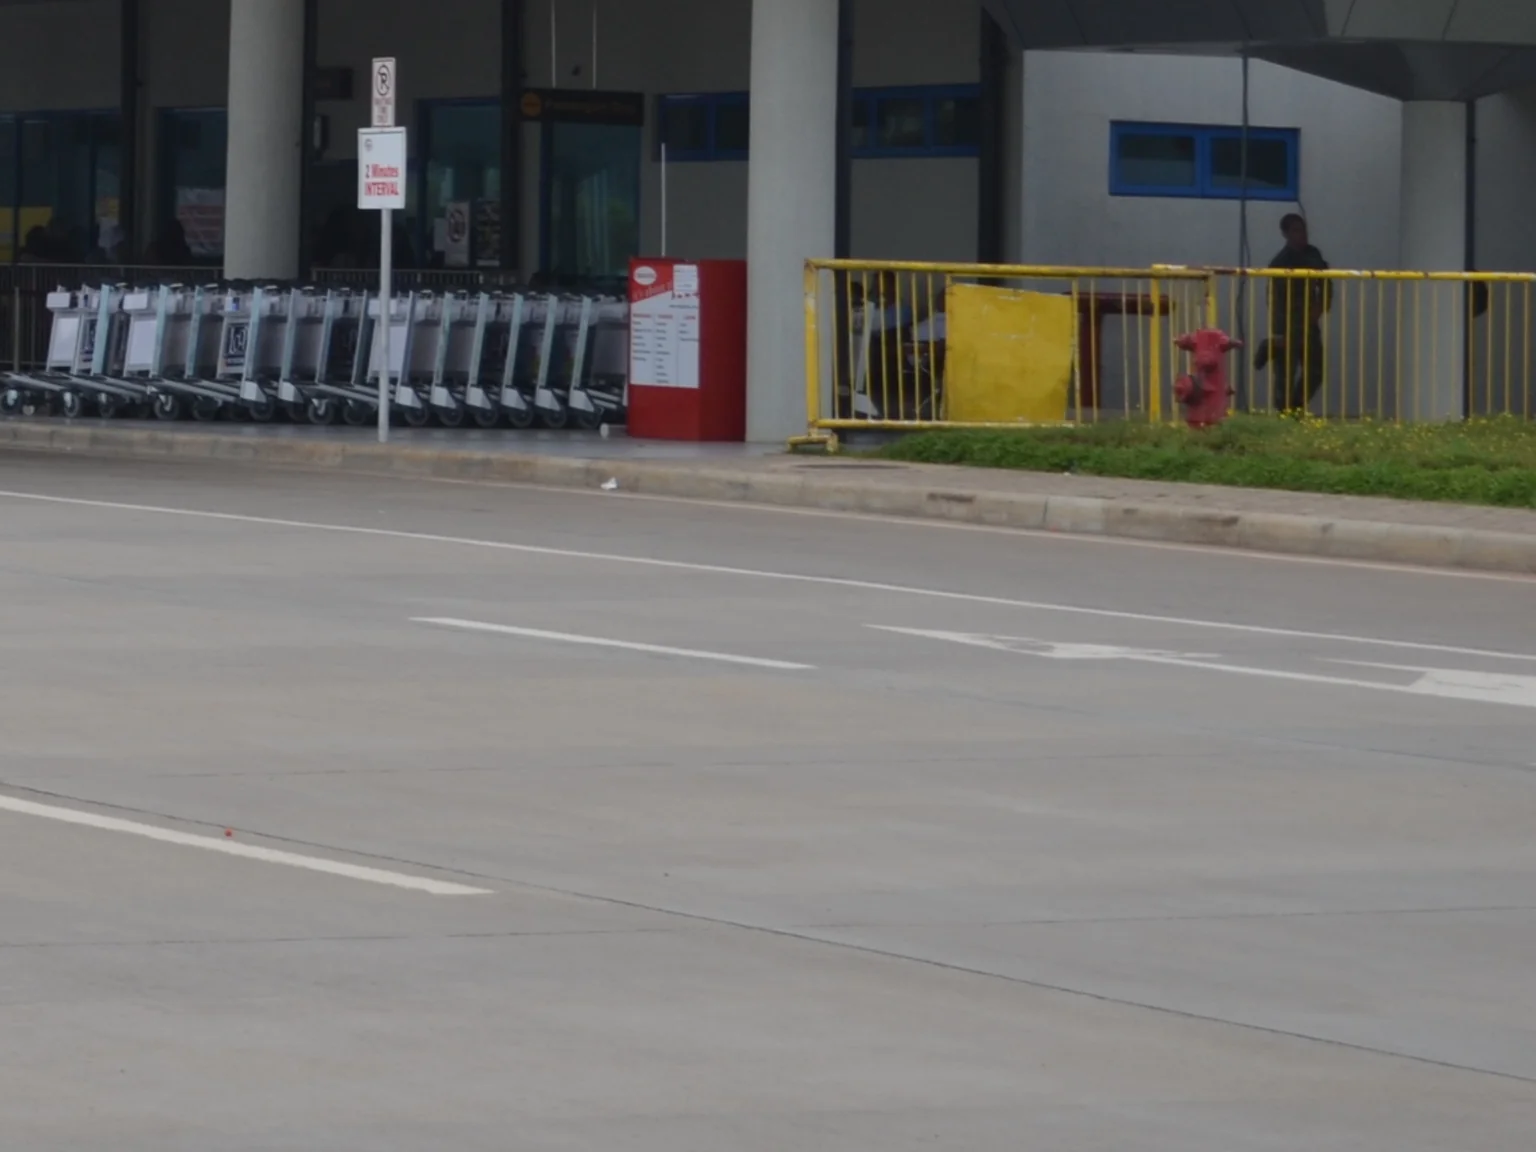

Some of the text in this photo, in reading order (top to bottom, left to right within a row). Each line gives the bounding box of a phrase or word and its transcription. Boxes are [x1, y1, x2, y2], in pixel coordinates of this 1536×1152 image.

[365, 163, 399, 179] 2 Minutes
[364, 181, 400, 196] INTERVAL
